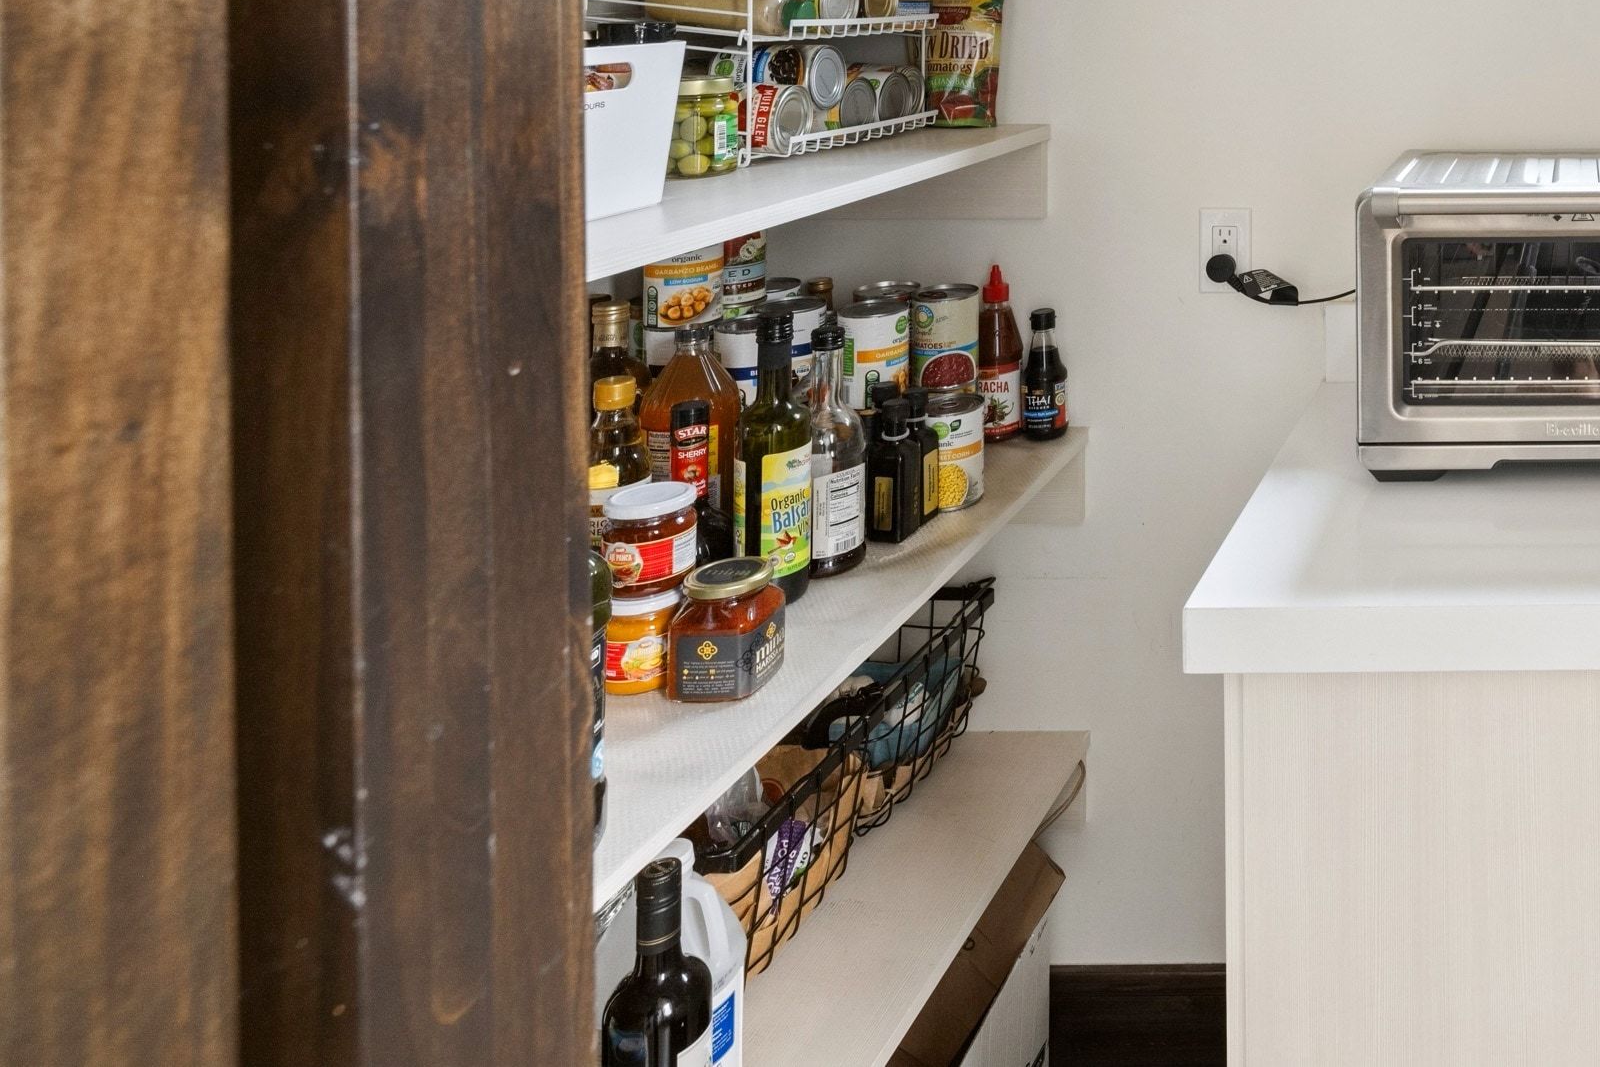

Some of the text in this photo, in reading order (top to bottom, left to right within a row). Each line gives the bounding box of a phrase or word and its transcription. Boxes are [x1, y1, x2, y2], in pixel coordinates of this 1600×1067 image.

[926, 61, 973, 74] omatoes
[584, 101, 606, 110] OURS
[760, 89, 774, 113] MUIR
[754, 116, 767, 142] GLEN
[671, 254, 703, 263] organic
[725, 282, 752, 290] ASTED
[978, 381, 1010, 393] RACHA
[1026, 395, 1051, 407] THAI
[678, 426, 707, 438] STAR
[1546, 421, 1600, 437] Breville
[678, 447, 707, 459] SHERRY
[770, 488, 806, 511] Organic
